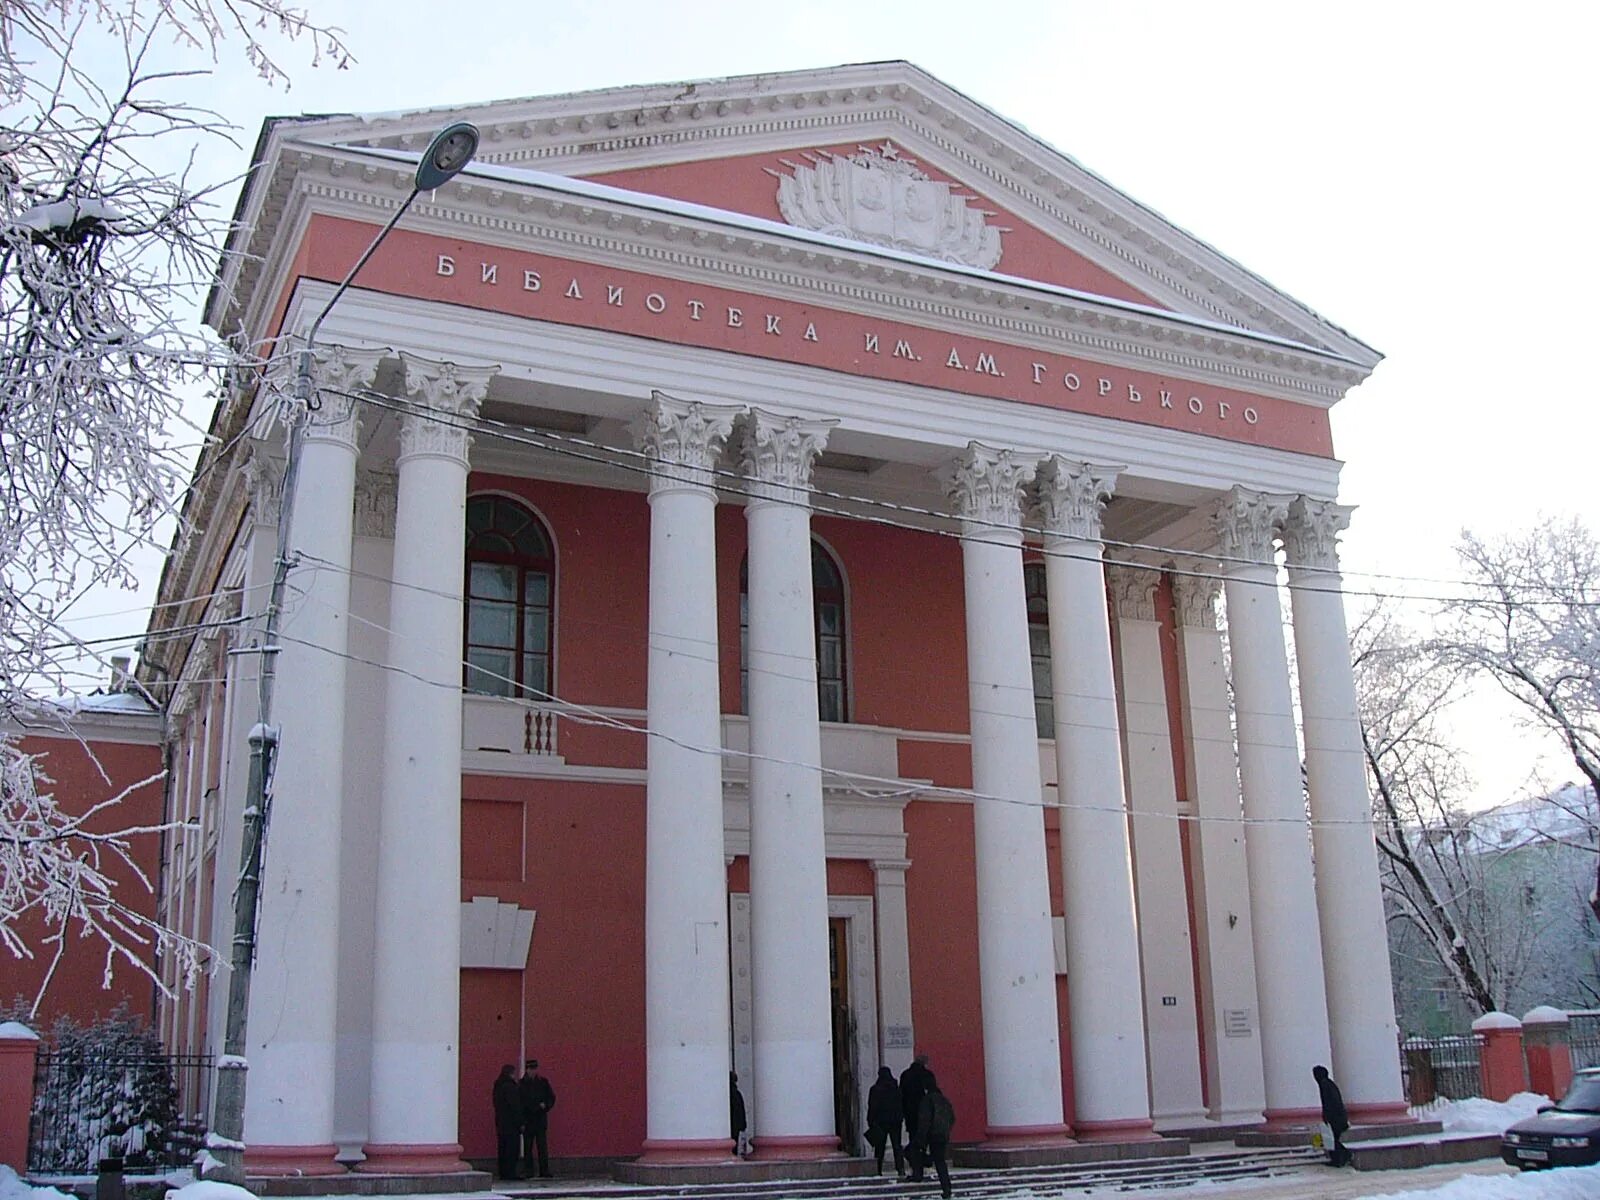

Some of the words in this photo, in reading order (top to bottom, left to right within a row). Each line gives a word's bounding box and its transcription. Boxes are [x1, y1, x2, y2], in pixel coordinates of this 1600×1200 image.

[437, 255, 819, 341] БИБЛИОТЕКА
[864, 333, 922, 361] ИМ.
[1033, 362, 1259, 424] ГОРЬКОГО
